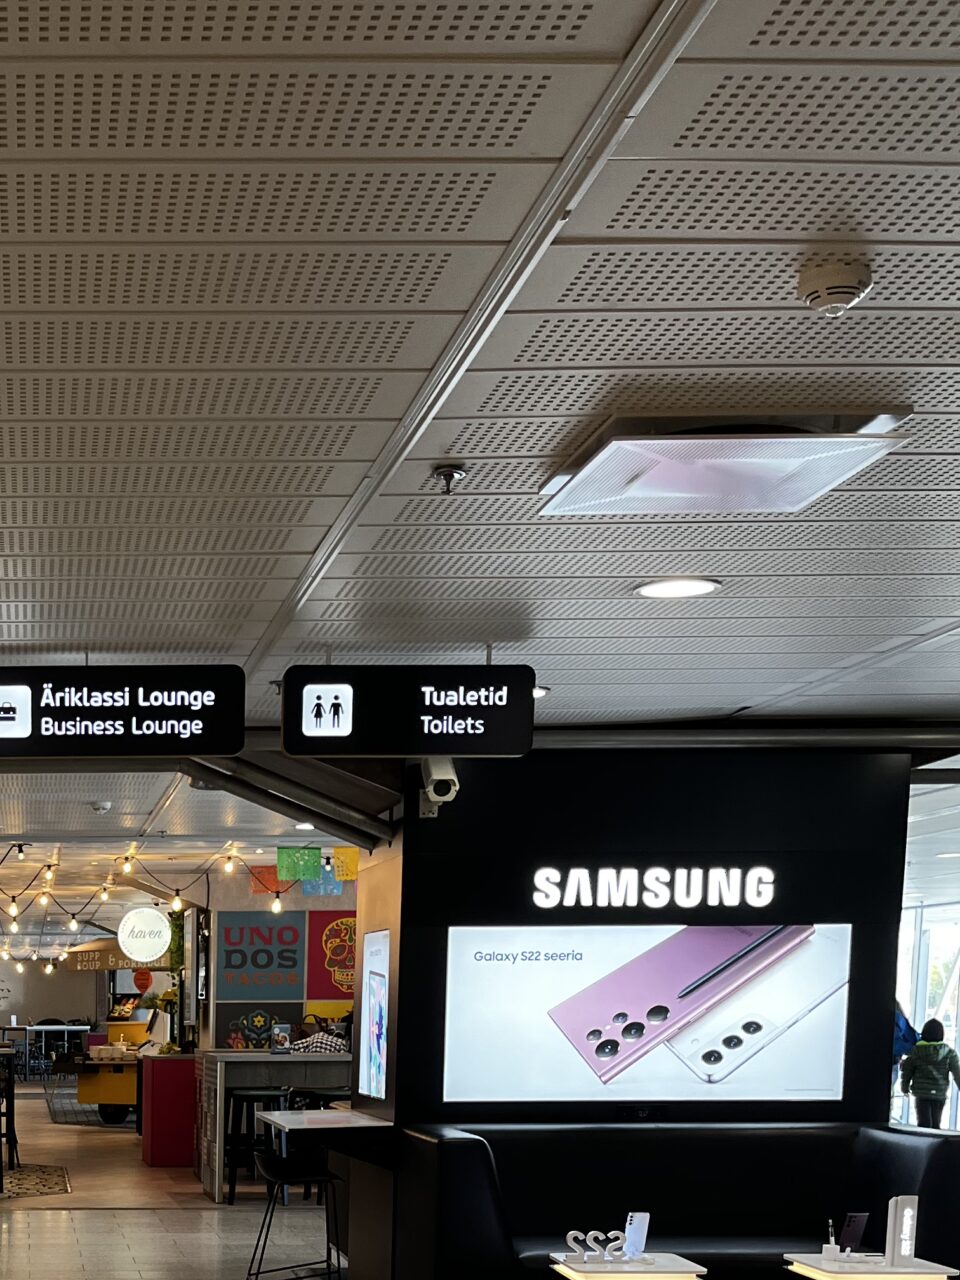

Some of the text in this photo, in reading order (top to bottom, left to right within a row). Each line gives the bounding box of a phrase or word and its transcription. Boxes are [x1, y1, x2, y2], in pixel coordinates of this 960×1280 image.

[40, 683, 216, 710] Äriklassi Lounge
[421, 686, 508, 706] Tualetid
[40, 716, 203, 738] Business Lounge
[421, 716, 485, 734] Toilets
[532, 866, 776, 909] SAMSUNG
[127, 925, 163, 939] haven
[223, 925, 300, 947] UNO
[77, 952, 101, 961] SUPP
[223, 948, 298, 970] DOS
[474, 950, 583, 965] Galaxy S22 seeria
[224, 973, 299, 986] TACOS
